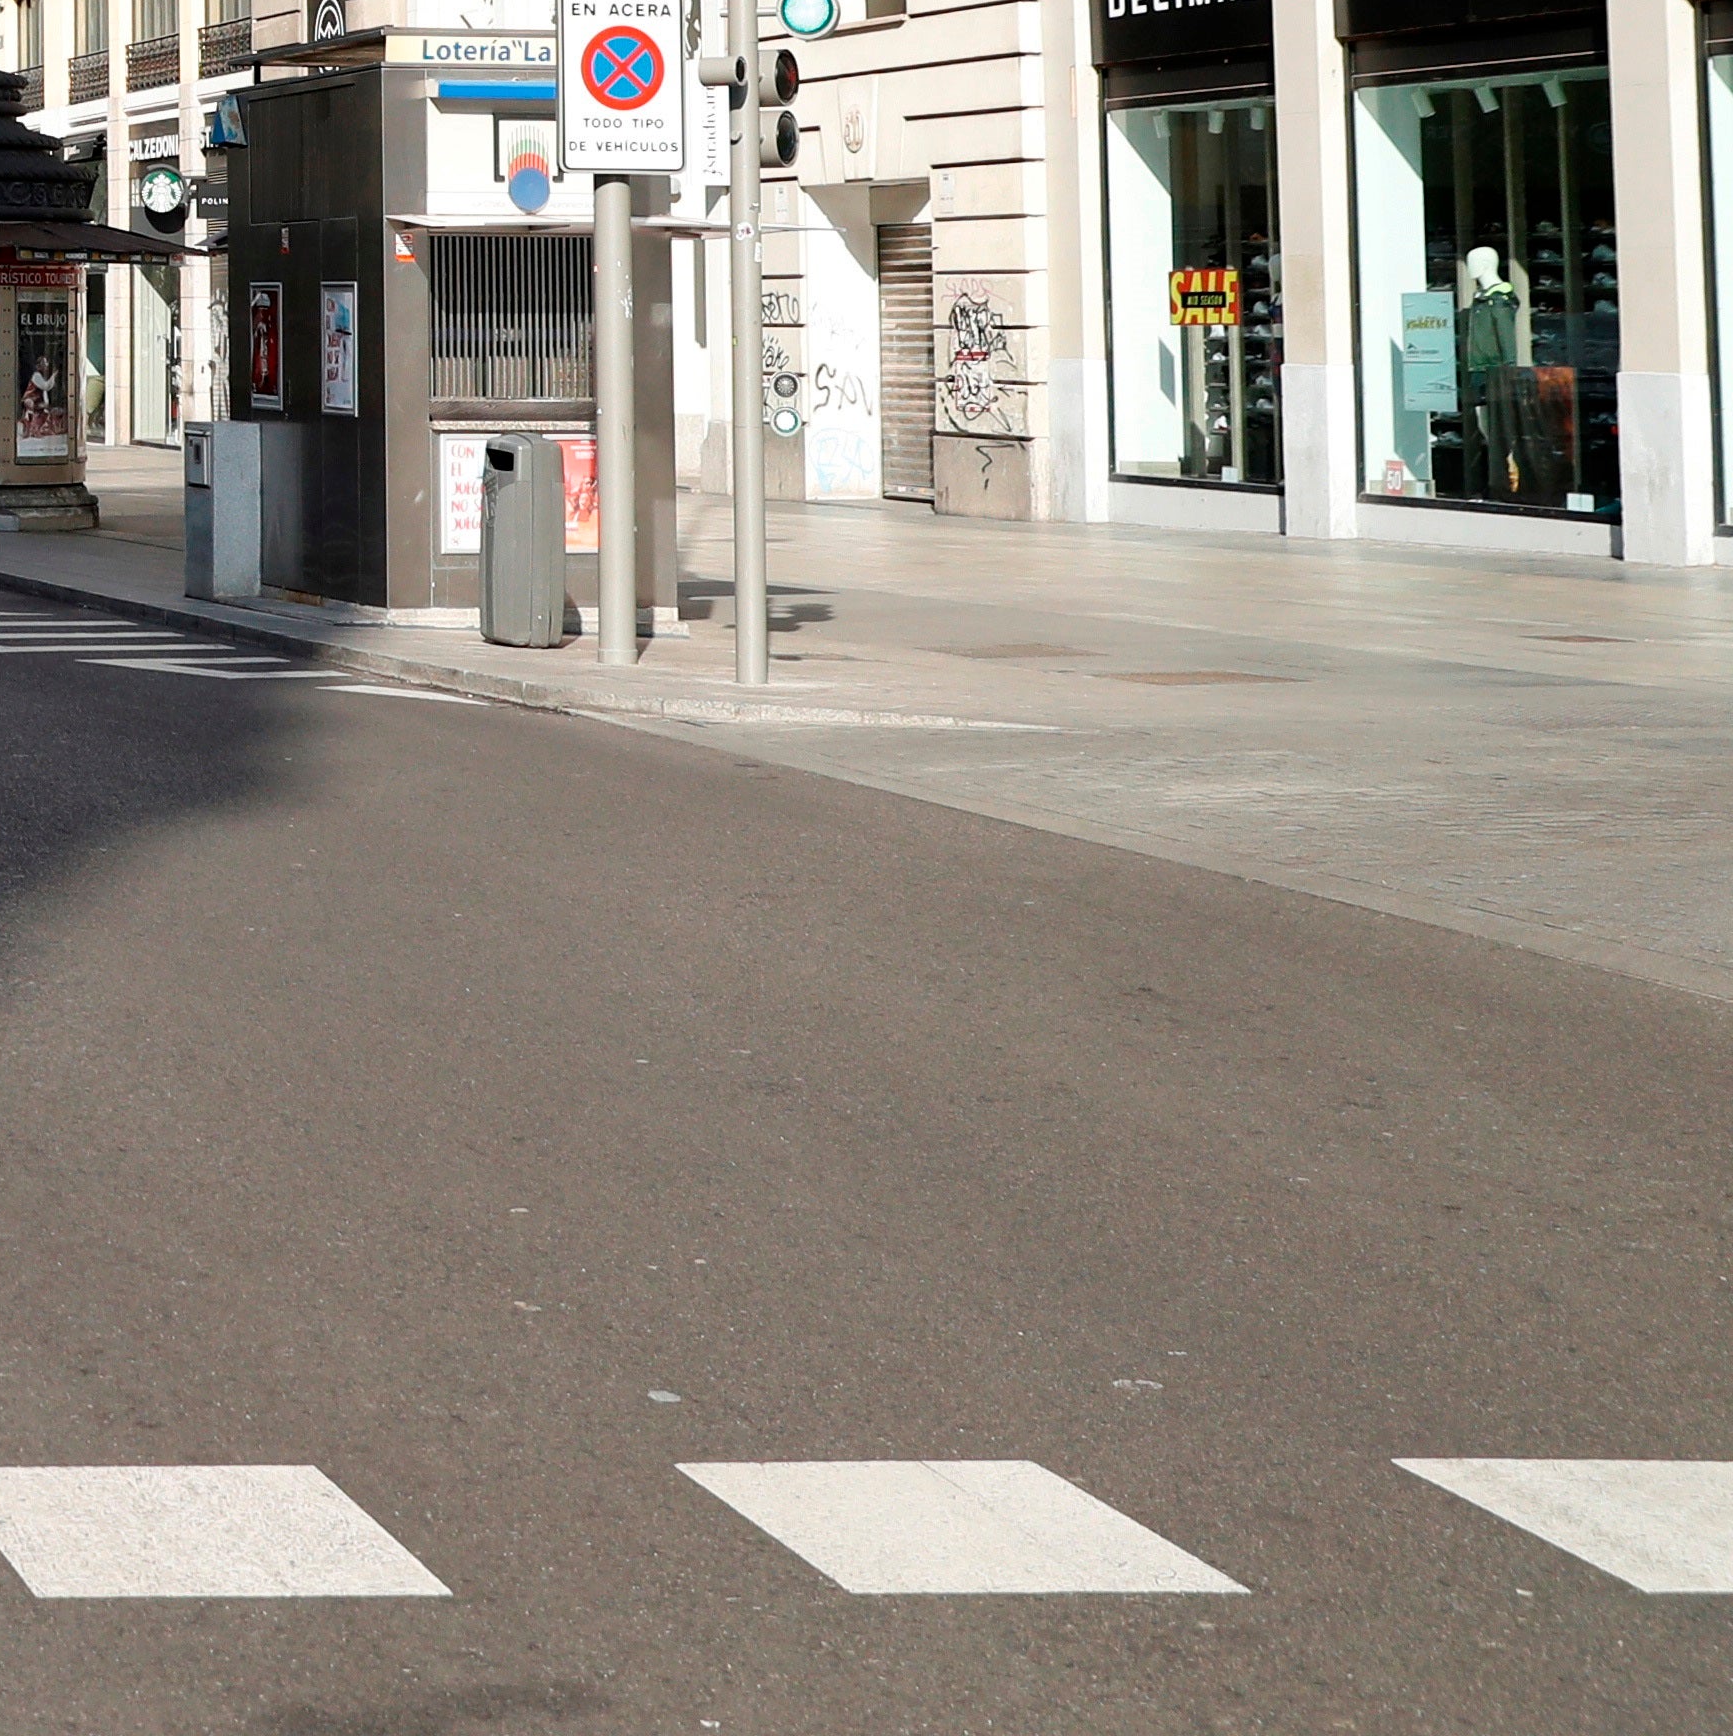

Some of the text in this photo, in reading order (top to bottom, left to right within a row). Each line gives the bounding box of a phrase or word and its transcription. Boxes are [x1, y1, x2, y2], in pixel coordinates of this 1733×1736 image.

[571, 3, 673, 18] EN ACERA
[422, 39, 511, 62] Lotería
[582, 118, 665, 130] TODO TIPO
[129, 134, 180, 162] CALZEDONI
[568, 139, 679, 153] DE VEHÍCULOS
[201, 197, 229, 206] POLIN
[1170, 271, 1238, 324] SALE
[20, 313, 67, 328] EL BRUJO
[450, 444, 476, 459] CON
[450, 500, 469, 513] NO
